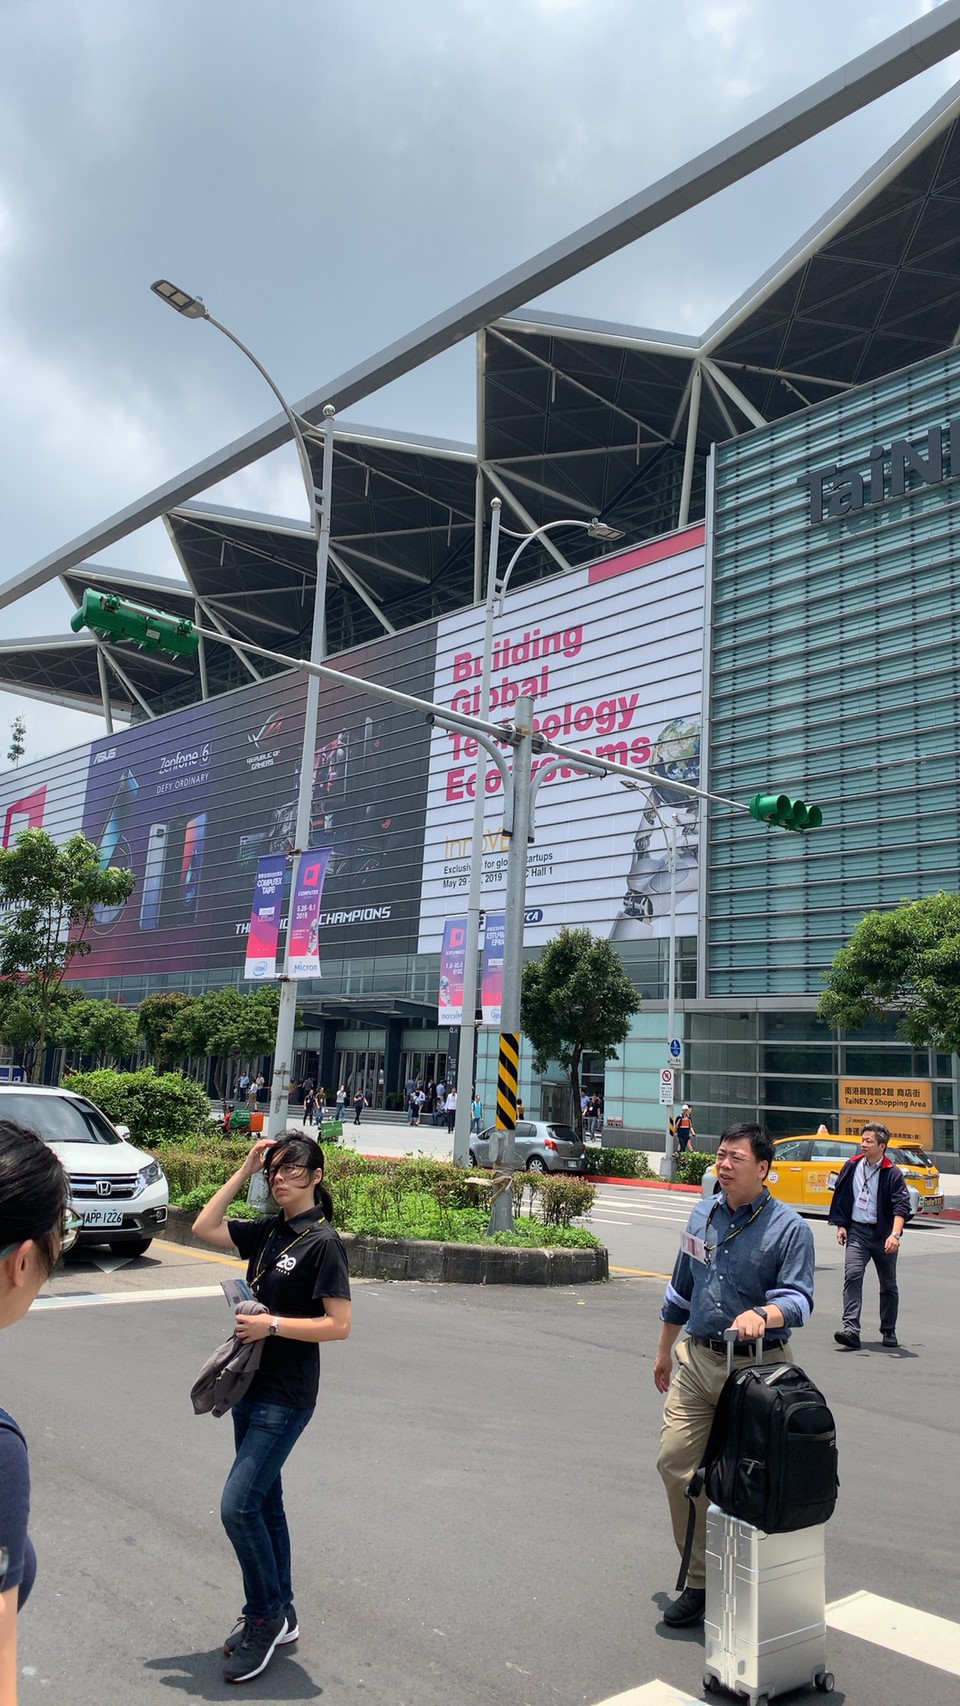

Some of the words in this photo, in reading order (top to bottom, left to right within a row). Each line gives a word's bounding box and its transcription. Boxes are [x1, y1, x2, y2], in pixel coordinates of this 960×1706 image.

[797, 421, 960, 524] TaiN
[93, 748, 117, 764] ASUS
[159, 751, 199, 775] Zenfone
[202, 743, 209, 762] 6
[246, 752, 272, 764] REPUBLIC
[251, 759, 273, 770] GAMERS
[156, 783, 173, 794] DEFY
[174, 772, 210, 789] ORDINARY
[484, 860, 495, 869] for
[257, 877, 282, 887] COMPUTEX
[443, 880, 456, 889] May
[458, 878, 467, 886] 29
[485, 873, 502, 883] 2019
[531, 867, 546, 877] Hall
[549, 866, 553, 875] 1
[297, 889, 319, 897] COMPUTEX
[318, 906, 391, 926] CHAMPIONS
[845, 1097, 868, 1105] TaiNEX
[874, 1098, 908, 1108] Shopping
[910, 1100, 926, 1108] Area
[85, 1212, 122, 1223] APP-1226
[276, 1254, 297, 1271] 20
